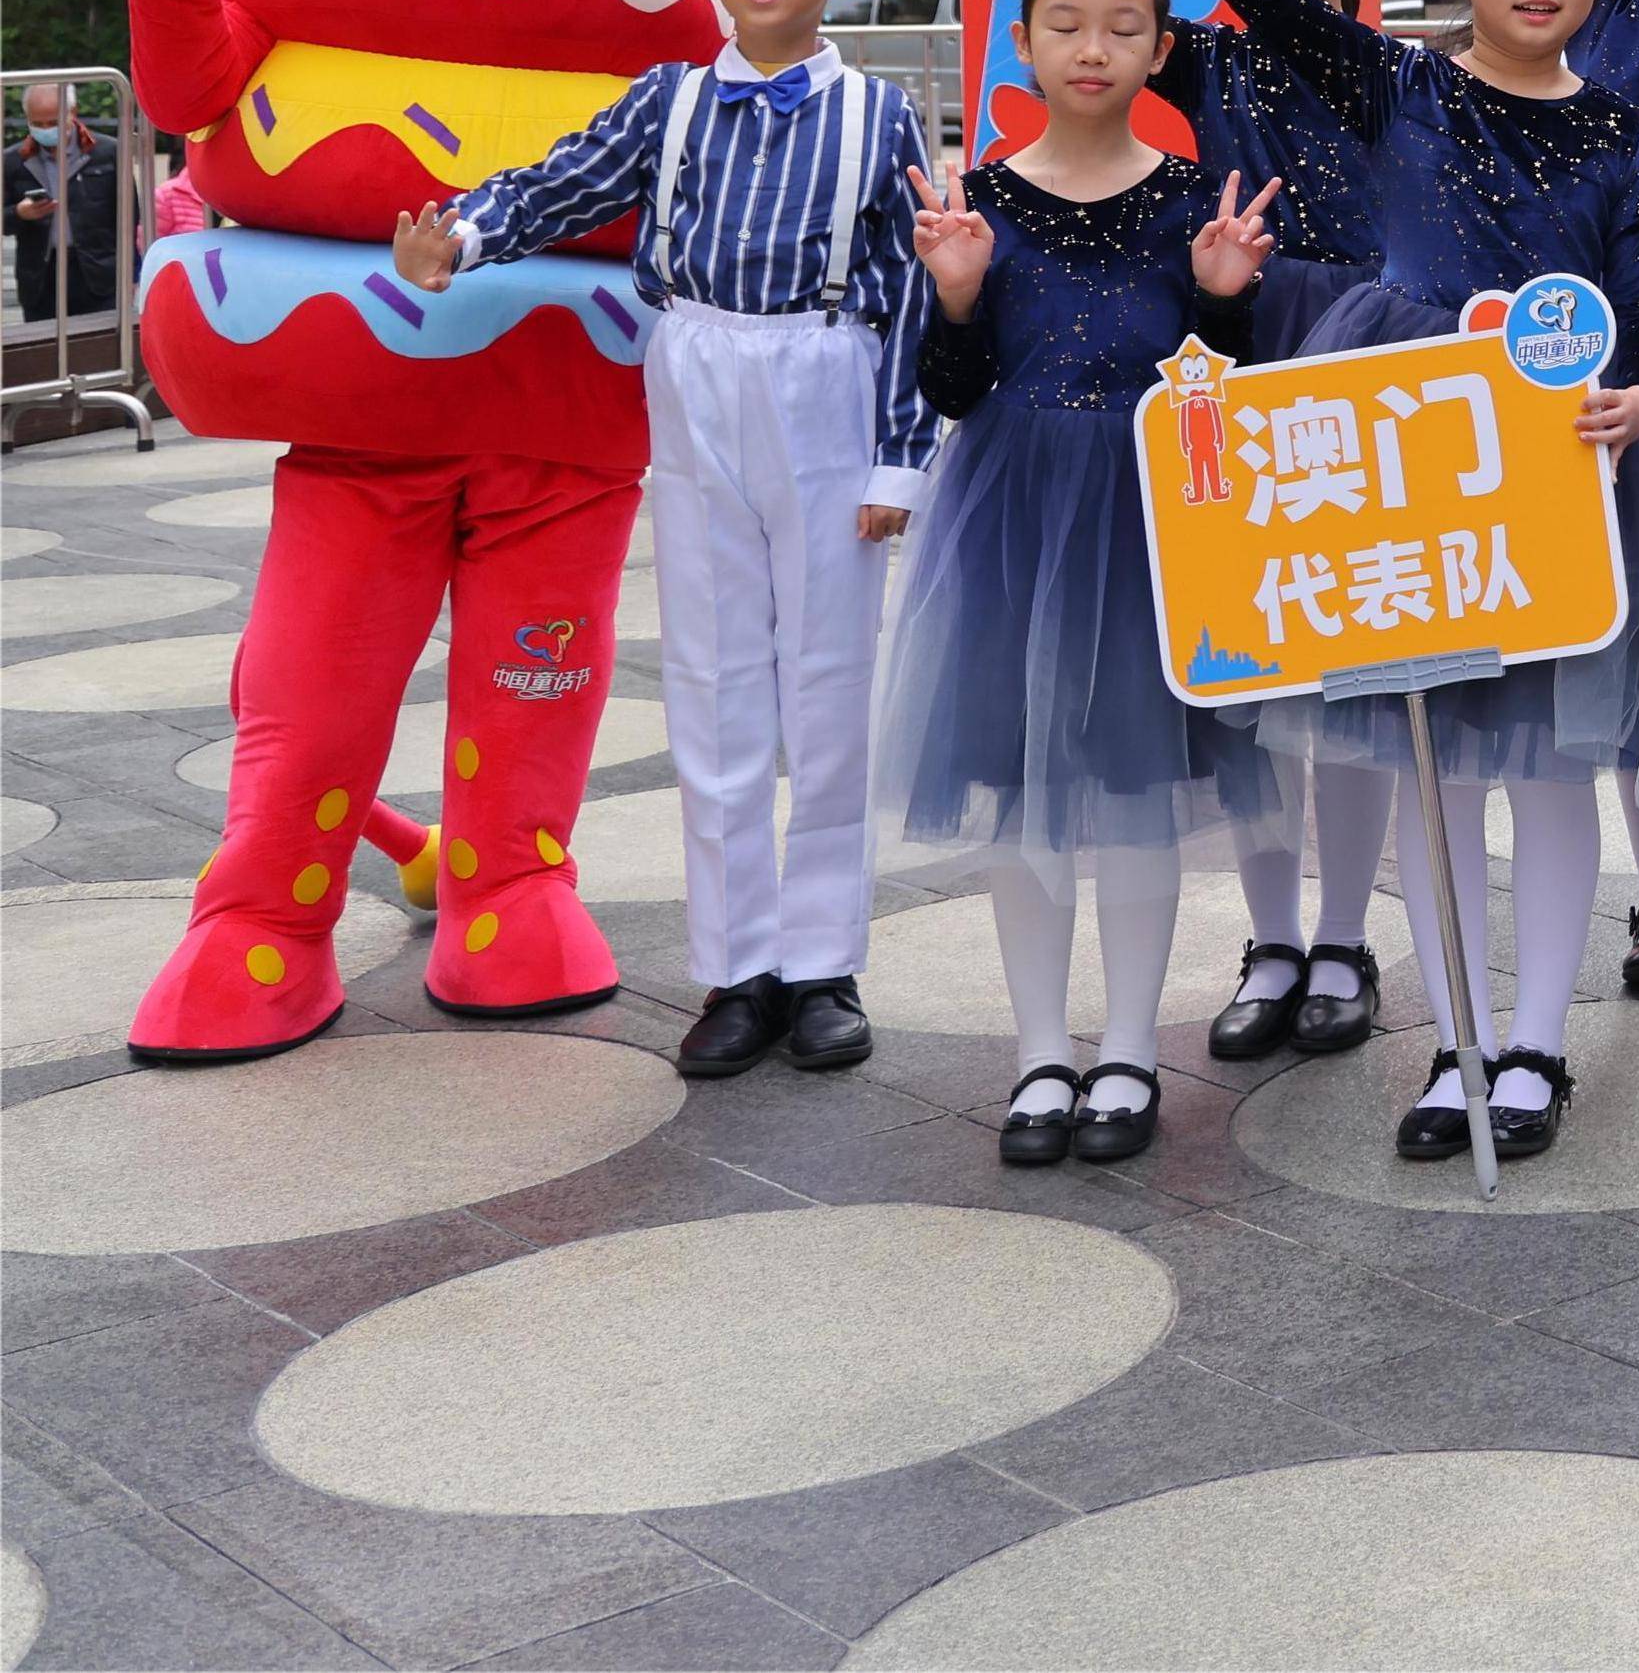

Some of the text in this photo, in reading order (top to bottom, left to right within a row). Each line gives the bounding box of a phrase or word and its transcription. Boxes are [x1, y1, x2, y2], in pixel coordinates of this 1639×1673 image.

[1518, 334, 1602, 364] 中国童话节
[1233, 372, 1503, 527] 澳门
[1253, 525, 1532, 645] 代表队
[493, 667, 592, 693] 中国童话节
